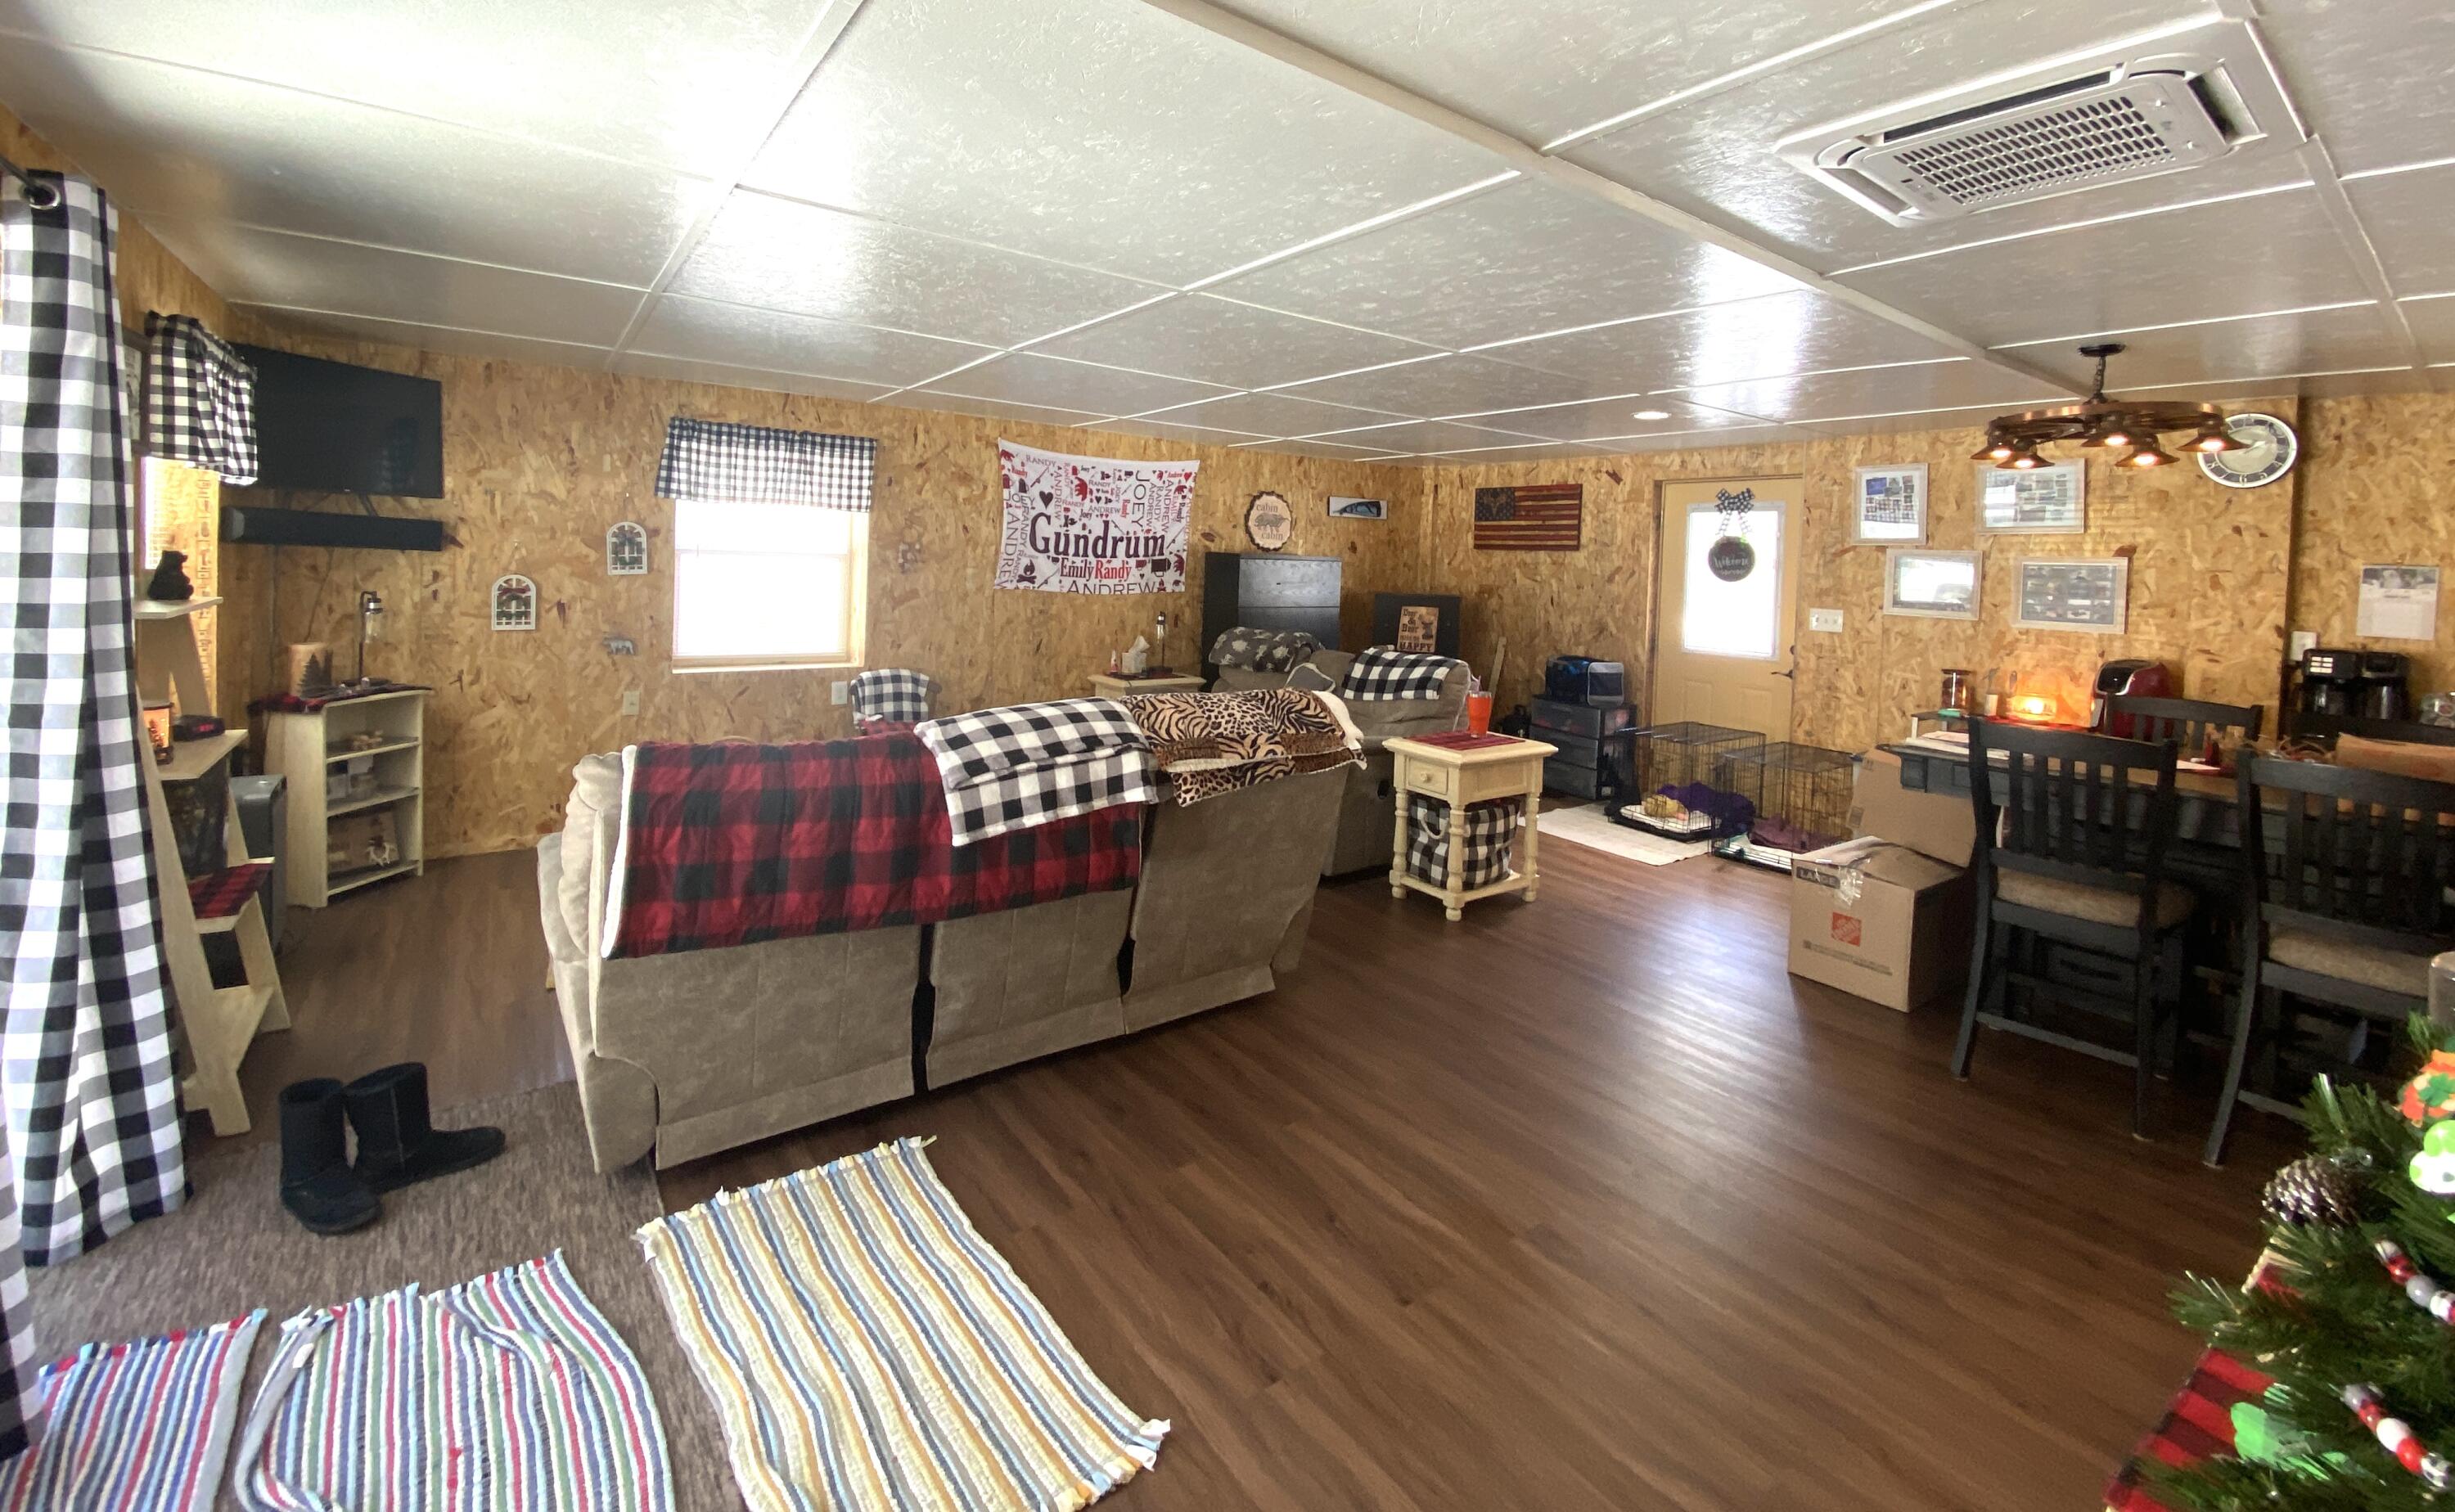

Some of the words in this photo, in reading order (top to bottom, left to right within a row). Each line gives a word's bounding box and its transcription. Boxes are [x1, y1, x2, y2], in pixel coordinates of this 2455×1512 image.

[1025, 453, 1056, 467] RANDY
[1088, 479, 1111, 488] RANDY
[1053, 470, 1063, 521] ANDREW
[1062, 498, 1085, 507] RANDY
[1132, 470, 1150, 528] JOEY
[1088, 505, 1121, 514] ANDREW
[1145, 482, 1157, 528] ANDREW
[1153, 486, 1164, 523] RANDY
[1162, 479, 1174, 533] ANDREW
[1257, 502, 1278, 512] cabin
[1079, 508, 1092, 521] Joey
[1029, 511, 1165, 559] Gundrum
[1261, 531, 1283, 540] cabin
[1061, 556, 1095, 582] Emily
[1095, 559, 1133, 583] Randy
[1400, 642, 1433, 651] HAPPY
